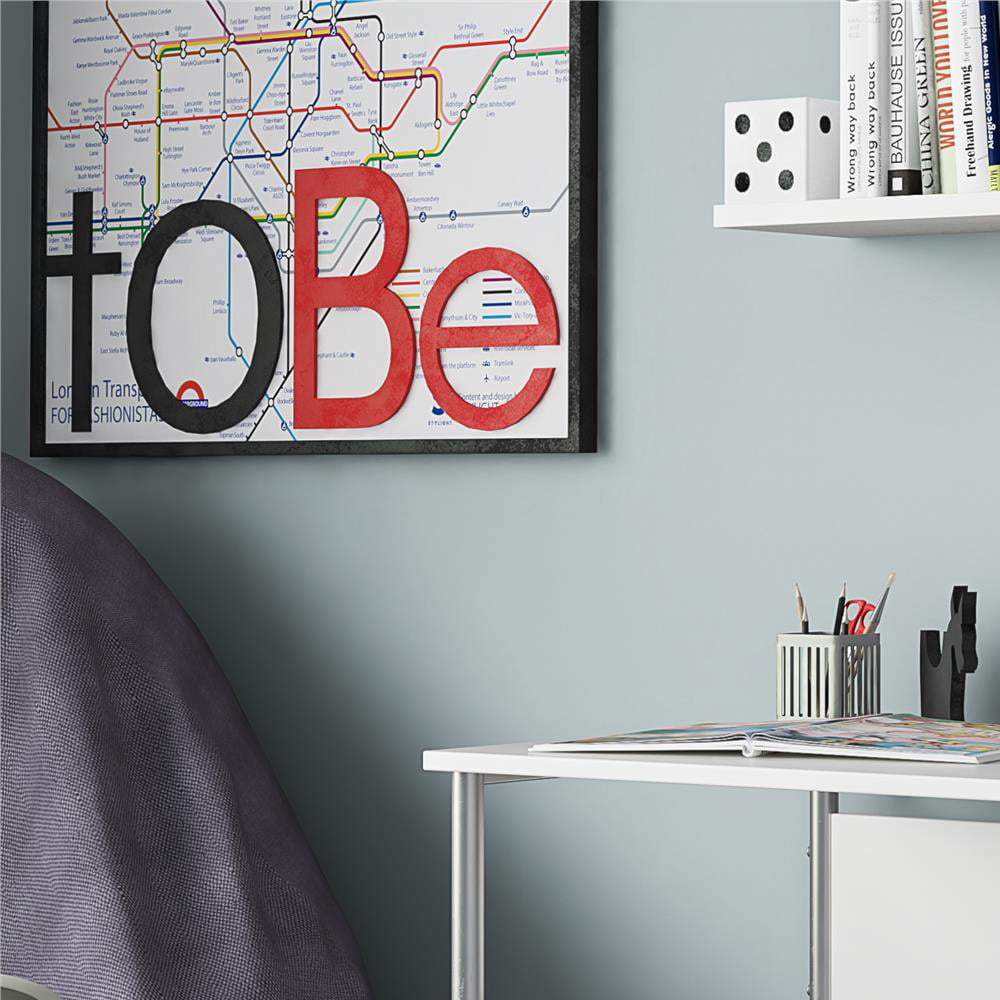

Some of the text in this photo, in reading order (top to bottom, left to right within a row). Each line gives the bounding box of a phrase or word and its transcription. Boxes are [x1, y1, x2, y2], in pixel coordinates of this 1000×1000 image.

[980, 14, 988, 43] World
[982, 44, 991, 66] New
[890, 55, 903, 165] BAUHAUSE
[914, 37, 934, 189] CHINA GREEN
[961, 64, 973, 117] Drawing
[984, 82, 993, 114] Goods
[847, 73, 858, 194] Wrong way back
[867, 60, 878, 188] Wrong way back
[962, 119, 977, 178] Freehand
